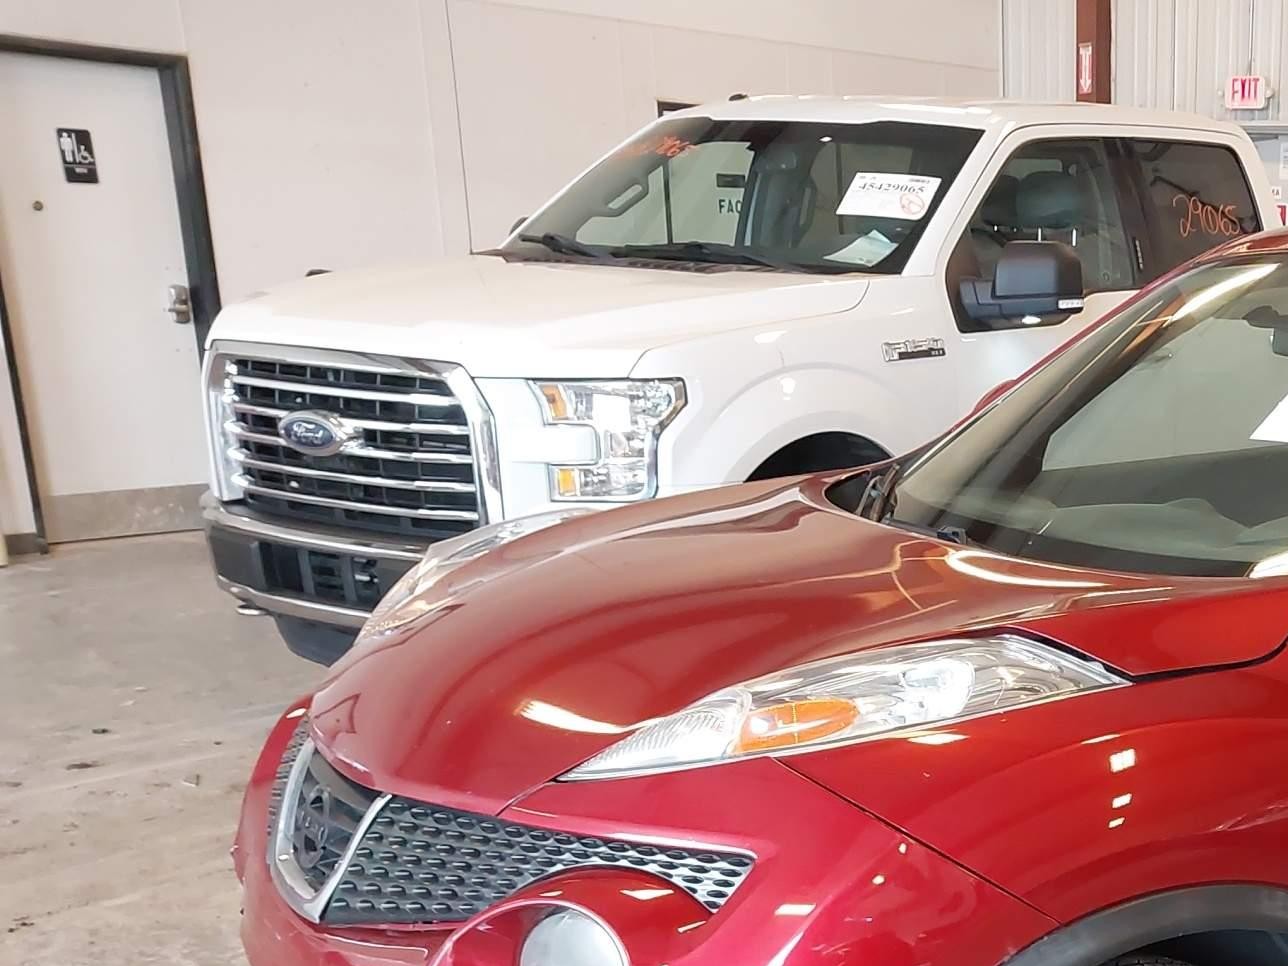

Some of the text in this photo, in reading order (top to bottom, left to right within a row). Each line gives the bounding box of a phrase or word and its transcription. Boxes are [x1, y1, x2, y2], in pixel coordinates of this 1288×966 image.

[1231, 78, 1260, 101] EXIT
[858, 182, 927, 195] 45429065
[1172, 193, 1241, 237] 29065
